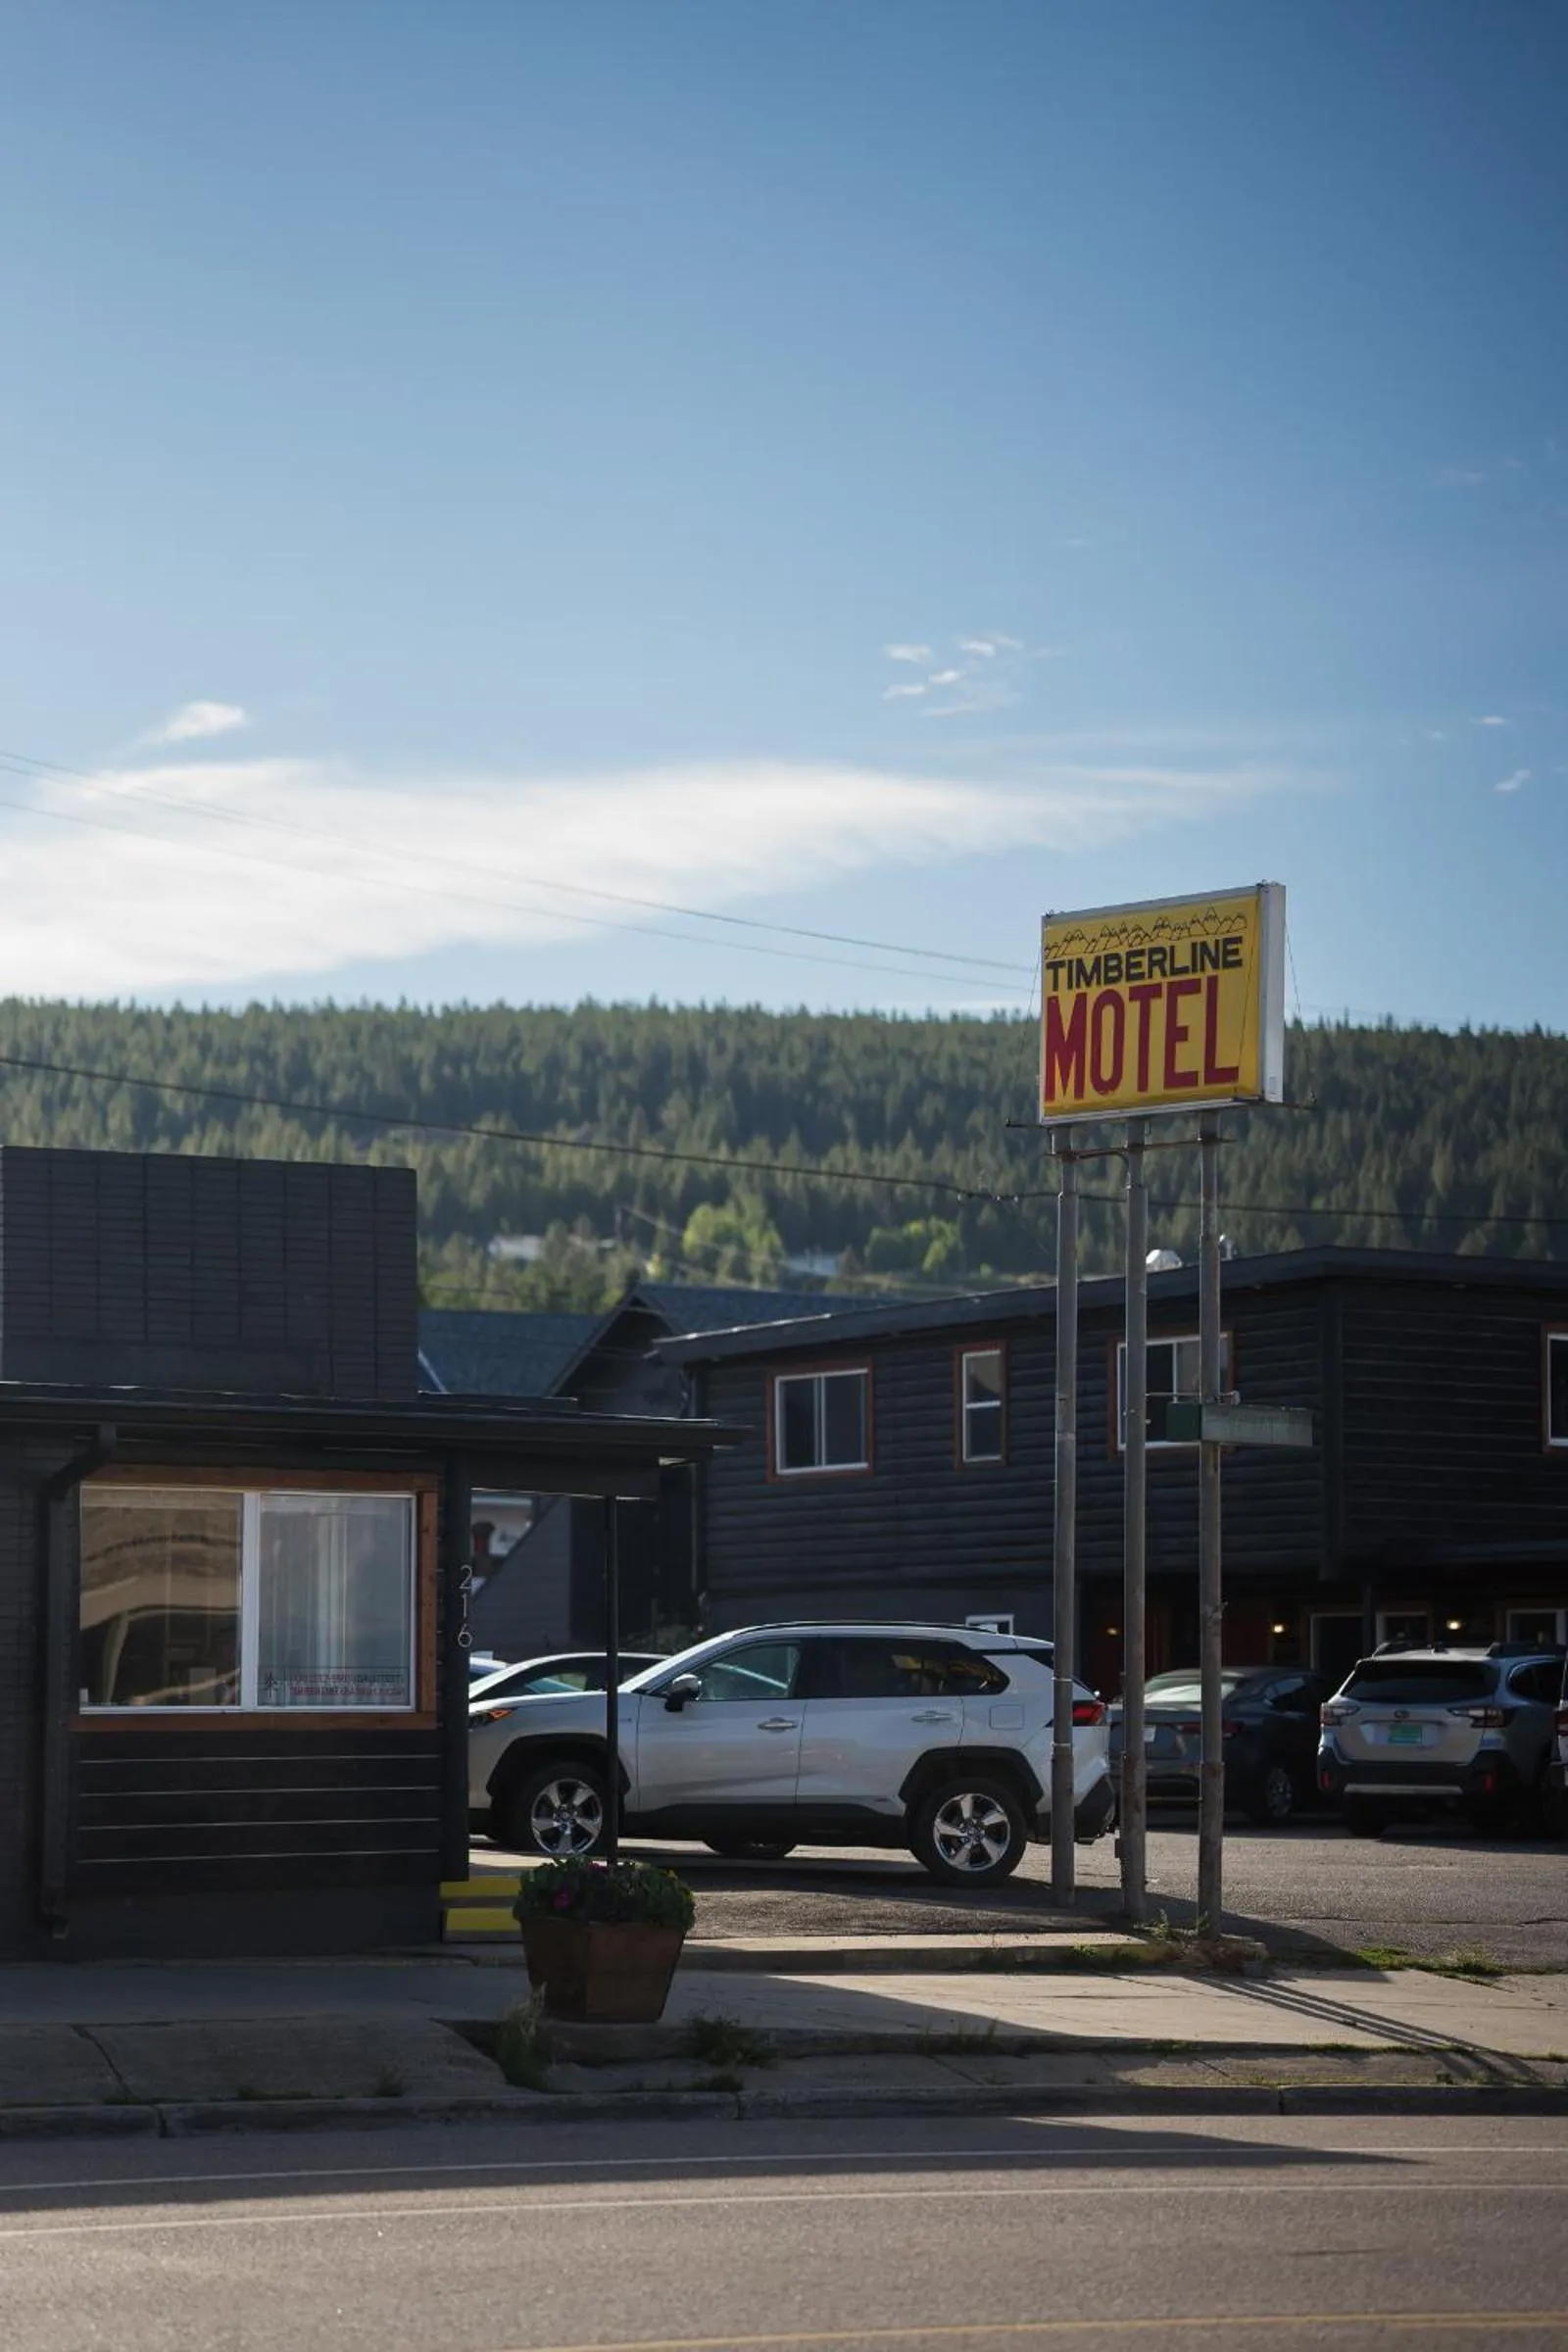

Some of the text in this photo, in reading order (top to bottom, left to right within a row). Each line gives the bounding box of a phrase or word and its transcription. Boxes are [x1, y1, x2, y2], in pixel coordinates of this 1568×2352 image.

[1045, 936, 1243, 992] TIMBERLINE
[1044, 975, 1240, 1102] MOTEL
[458, 1564, 472, 1647] 216
